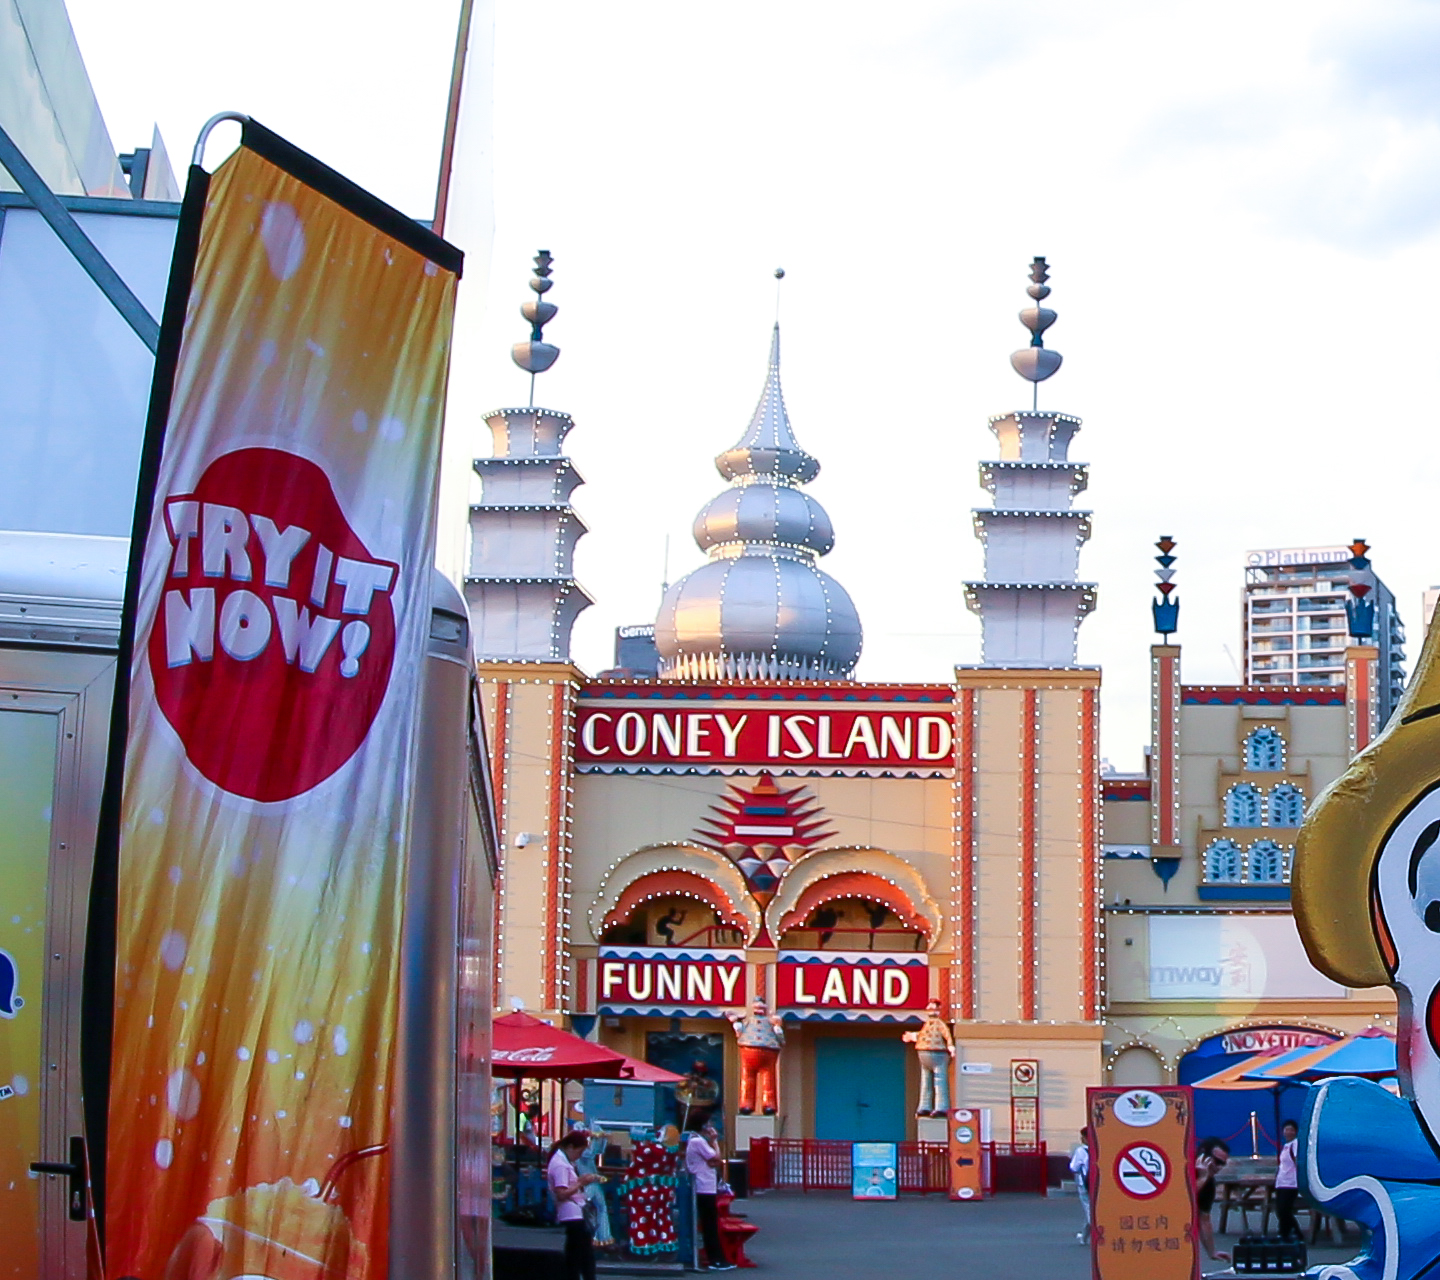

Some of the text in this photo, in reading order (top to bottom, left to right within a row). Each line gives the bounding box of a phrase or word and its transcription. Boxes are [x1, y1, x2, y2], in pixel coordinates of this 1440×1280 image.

[167, 501, 394, 615] TRY IT
[1265, 549, 1349, 567] Platinum
[165, 587, 370, 678] NOW!
[582, 711, 954, 761] CONEY ISLAND
[602, 962, 911, 1005] FUNNY LAND
